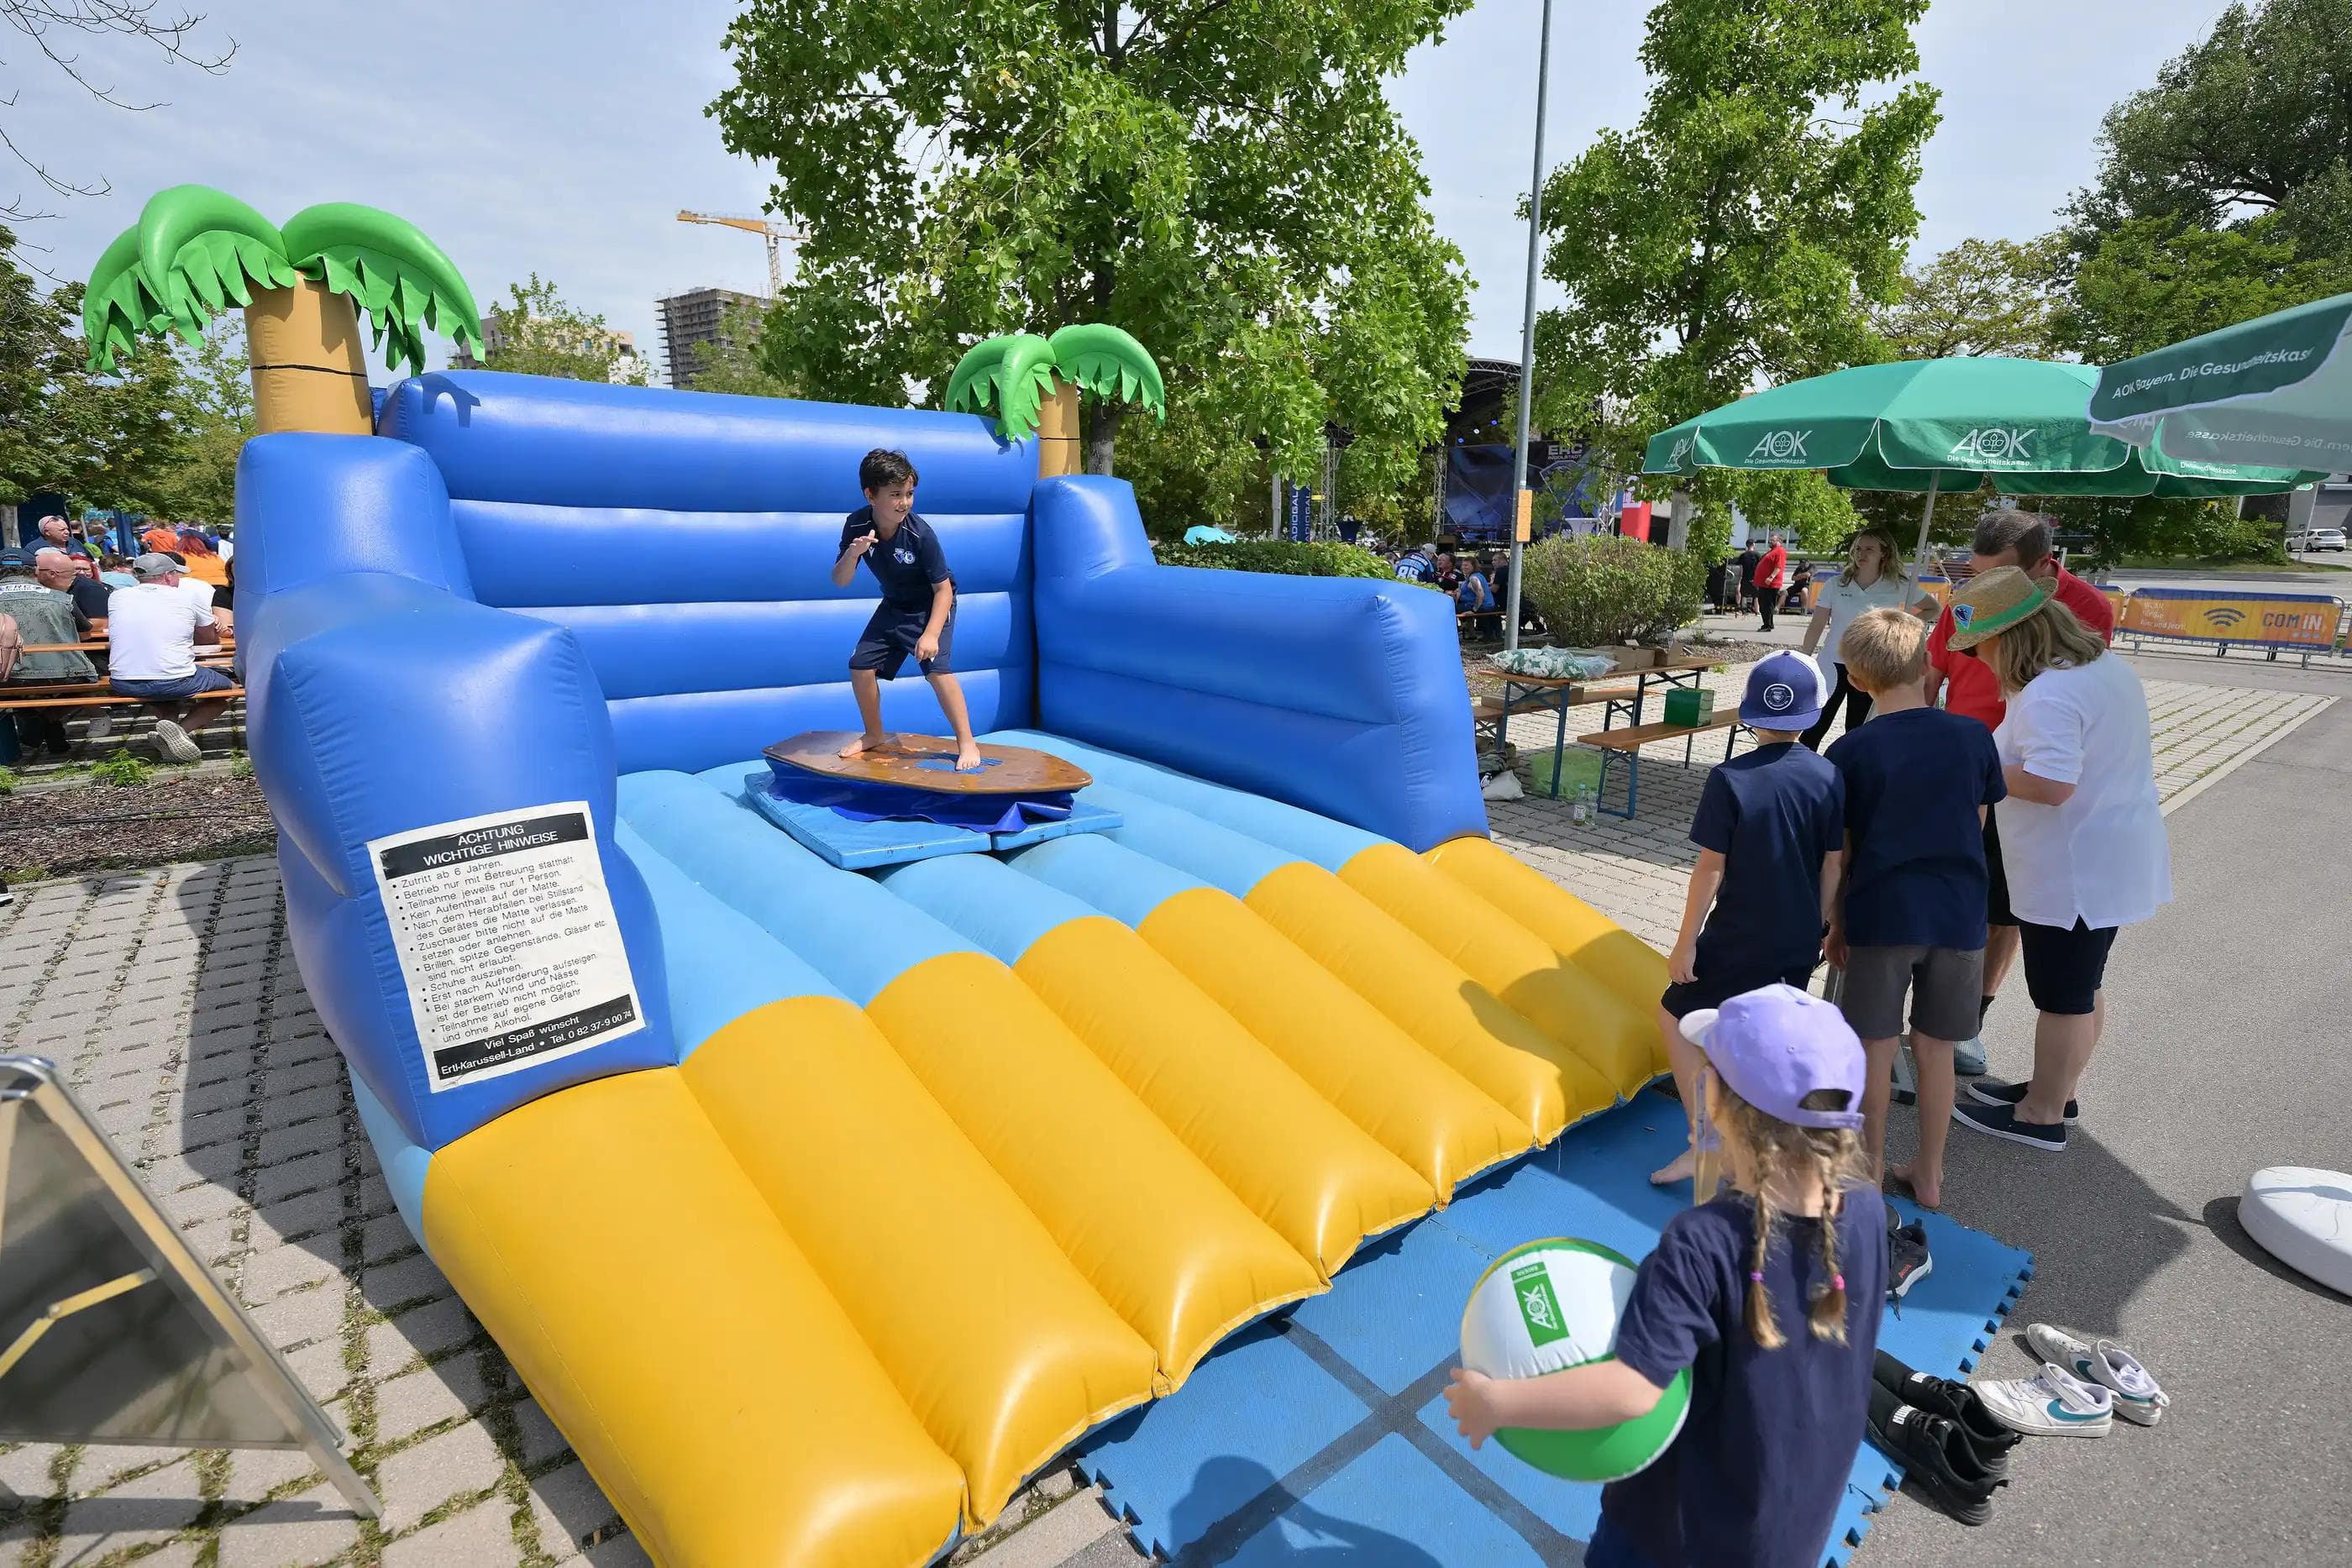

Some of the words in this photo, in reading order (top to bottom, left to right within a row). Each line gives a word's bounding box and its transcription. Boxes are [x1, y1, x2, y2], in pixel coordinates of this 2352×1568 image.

[2112, 381, 2136, 400] AOK
[2135, 372, 2176, 392] Bayern.
[2180, 366, 2199, 380] Die
[1748, 430, 1813, 457] AOK
[1949, 428, 2036, 458] AOK
[423, 844, 493, 866] WICHTIGE
[498, 831, 559, 852] HINWEISE
[458, 824, 524, 846] ACHTUNG
[402, 875, 432, 889] Zutritt
[437, 871, 449, 879] ab
[454, 868, 461, 876] 6
[467, 860, 503, 873] Jahren.
[404, 884, 439, 899] Betrieb
[444, 881, 459, 889] nur
[465, 876, 480, 885] mit
[485, 864, 534, 881] Betreuung
[538, 856, 575, 869] statthaft.
[407, 893, 456, 909] Teilnahme
[462, 883, 496, 899] jeweils
[500, 878, 515, 889] nur
[528, 870, 562, 883] Person.
[410, 910, 431, 921] Kein
[436, 896, 486, 915] Aufenthalt
[491, 891, 508, 901] auf
[512, 886, 528, 897] der
[533, 881, 560, 893] Matte.
[413, 919, 438, 931] Nach
[443, 912, 465, 924] dem
[469, 899, 525, 918] Herabfallen
[529, 894, 543, 904] bei
[547, 884, 584, 899] Stillstand
[417, 931, 434, 941] des
[438, 920, 479, 936] Gerätes
[483, 915, 497, 925] die
[502, 908, 530, 920] Matte
[534, 898, 578, 912] verlassen.
[418, 933, 470, 951] Zuschauer
[475, 926, 498, 937] bitte
[502, 920, 525, 931] nicht
[530, 915, 546, 925] auf
[549, 910, 563, 920] die
[565, 905, 589, 915] Matte
[422, 949, 454, 962] setzen
[459, 941, 481, 952] oder
[486, 930, 533, 946] anlehnen.
[424, 961, 455, 972] Brillen,
[459, 950, 490, 964] spitze
[494, 932, 561, 954] Gegenstände,
[564, 924, 591, 936] Gläser
[428, 972, 447, 982] sind
[450, 964, 474, 976] nicht
[479, 955, 516, 969] erlaubt.
[430, 977, 466, 992] Schuhe
[471, 963, 523, 981] ausziehen.
[432, 992, 451, 1003] Erst
[455, 985, 480, 997] nach
[485, 968, 549, 989] Aufforderung
[435, 1003, 450, 1013] Bei
[454, 993, 494, 1008] starkem
[498, 983, 524, 996] Wind
[528, 977, 546, 988] und
[549, 968, 579, 981] Nässe
[437, 1013, 448, 1023] ist
[453, 1009, 469, 1019] der
[473, 999, 509, 1013] Betrieb
[513, 991, 537, 1003] nicht
[541, 979, 579, 994] möglich.
[440, 1015, 488, 1034] Teilnahme
[493, 1009, 508, 1020] auf
[513, 999, 546, 1014] eigene
[550, 988, 581, 1003] Gefahr
[443, 1034, 460, 1043] und
[465, 1026, 489, 1038] ohne
[494, 1013, 532, 1030] Alkohol.
[441, 1042, 535, 1075] Ertl-Karussell-Land
[549, 1034, 567, 1045] Tel.
[568, 1030, 575, 1039] 0
[576, 1026, 589, 1036] 82
[612, 1014, 622, 1024] 00
[622, 1010, 633, 1019] 74
[485, 1038, 505, 1050] Viel
[508, 1029, 535, 1044] Spaß
[539, 1016, 580, 1034] wünscht
[1521, 1283, 1552, 1329] AOK
